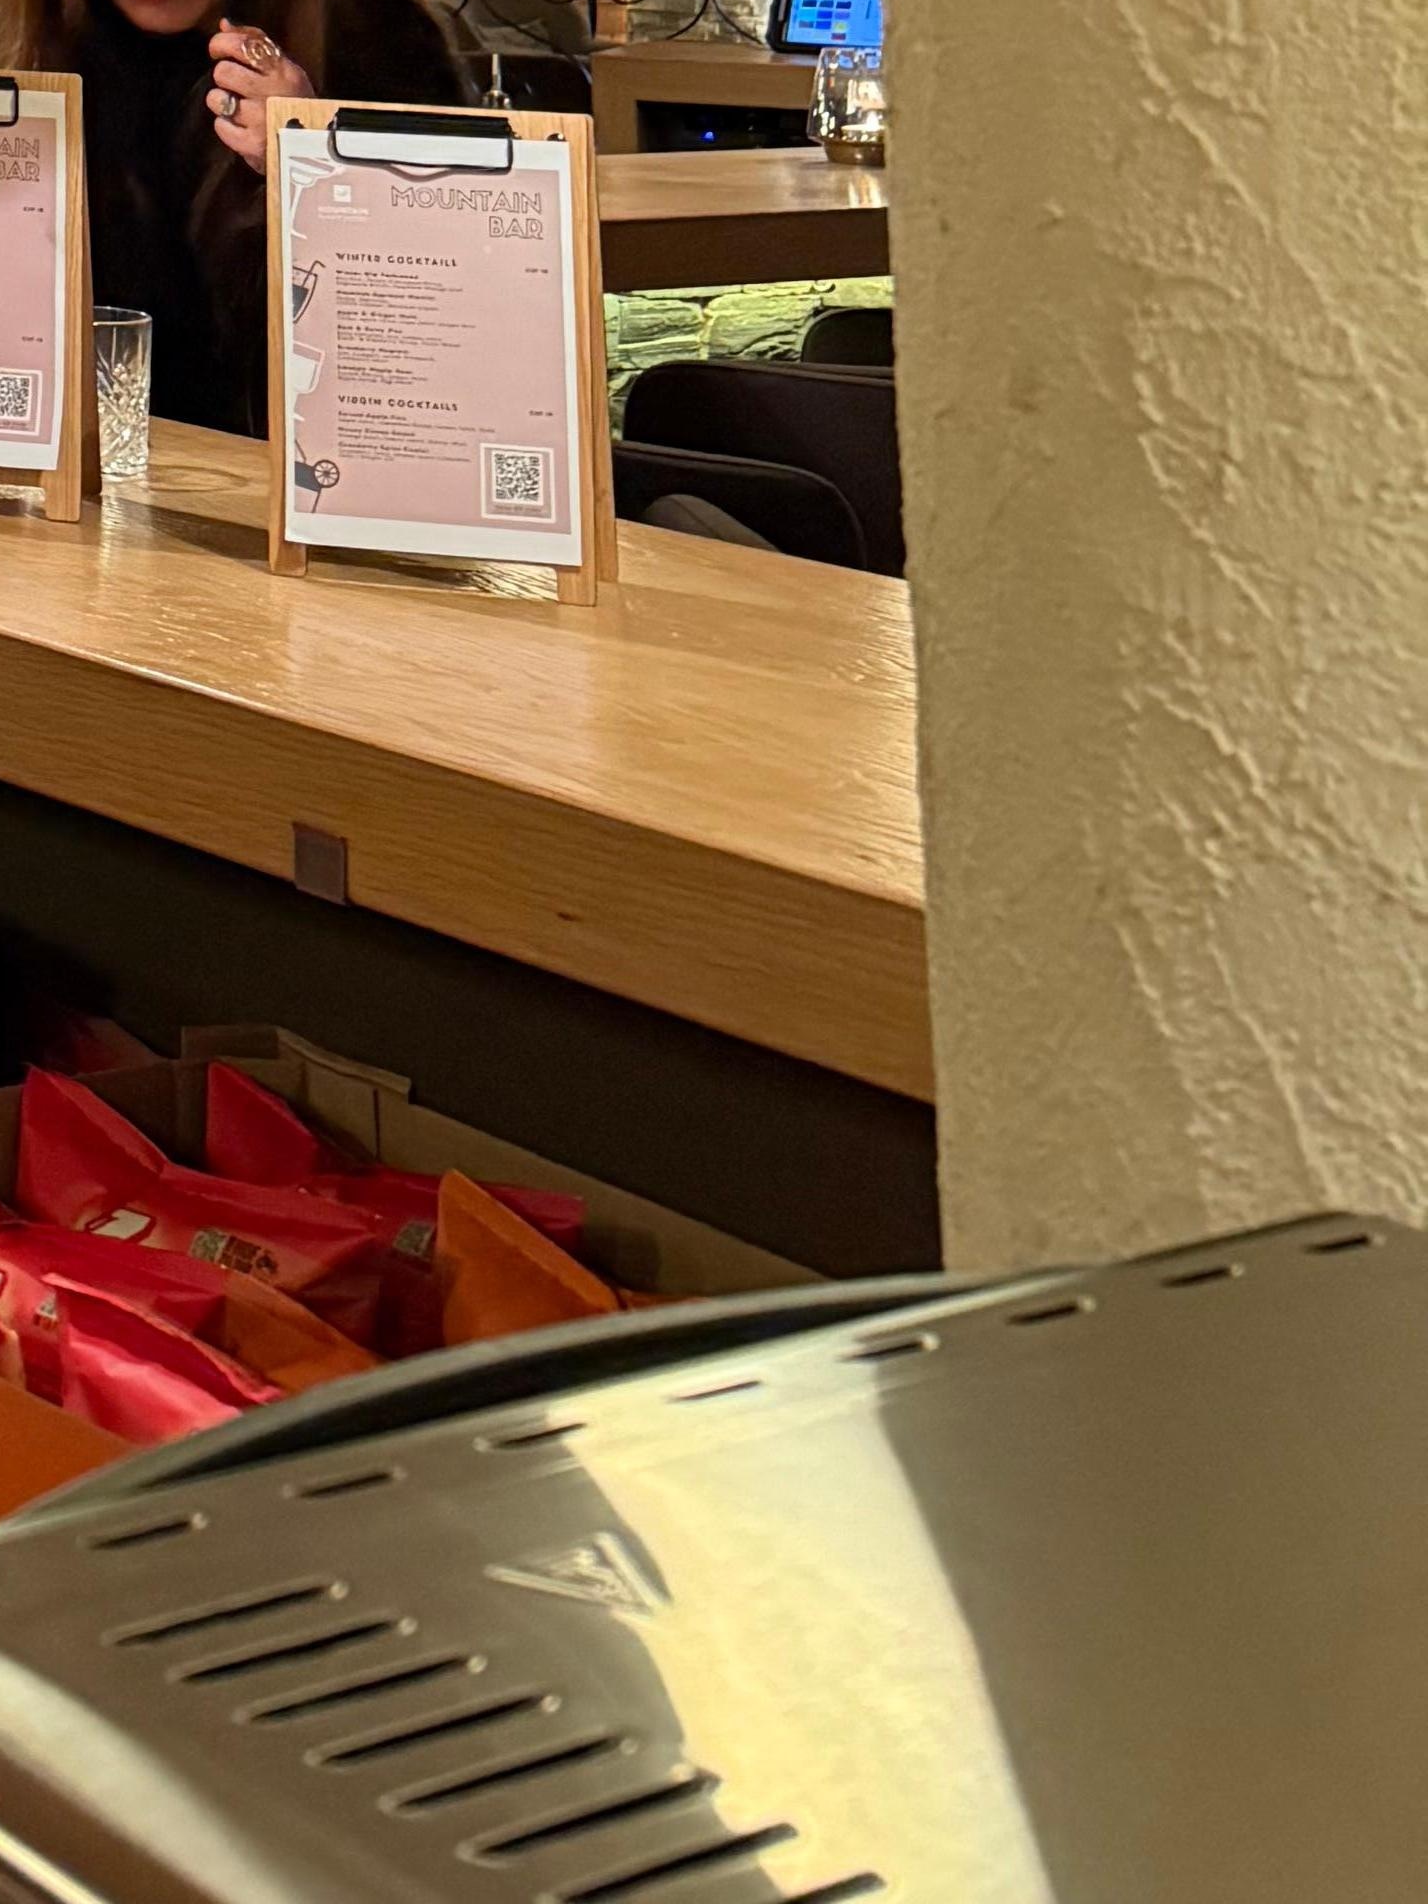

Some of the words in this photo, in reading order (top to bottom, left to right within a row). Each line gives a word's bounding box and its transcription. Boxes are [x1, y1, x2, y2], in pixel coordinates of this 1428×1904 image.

[390, 185, 543, 215] MOUNTAIN
[488, 215, 544, 240] BAR
[387, 254, 458, 268] COCKTAILS
[387, 398, 459, 412] COCKTAILS
